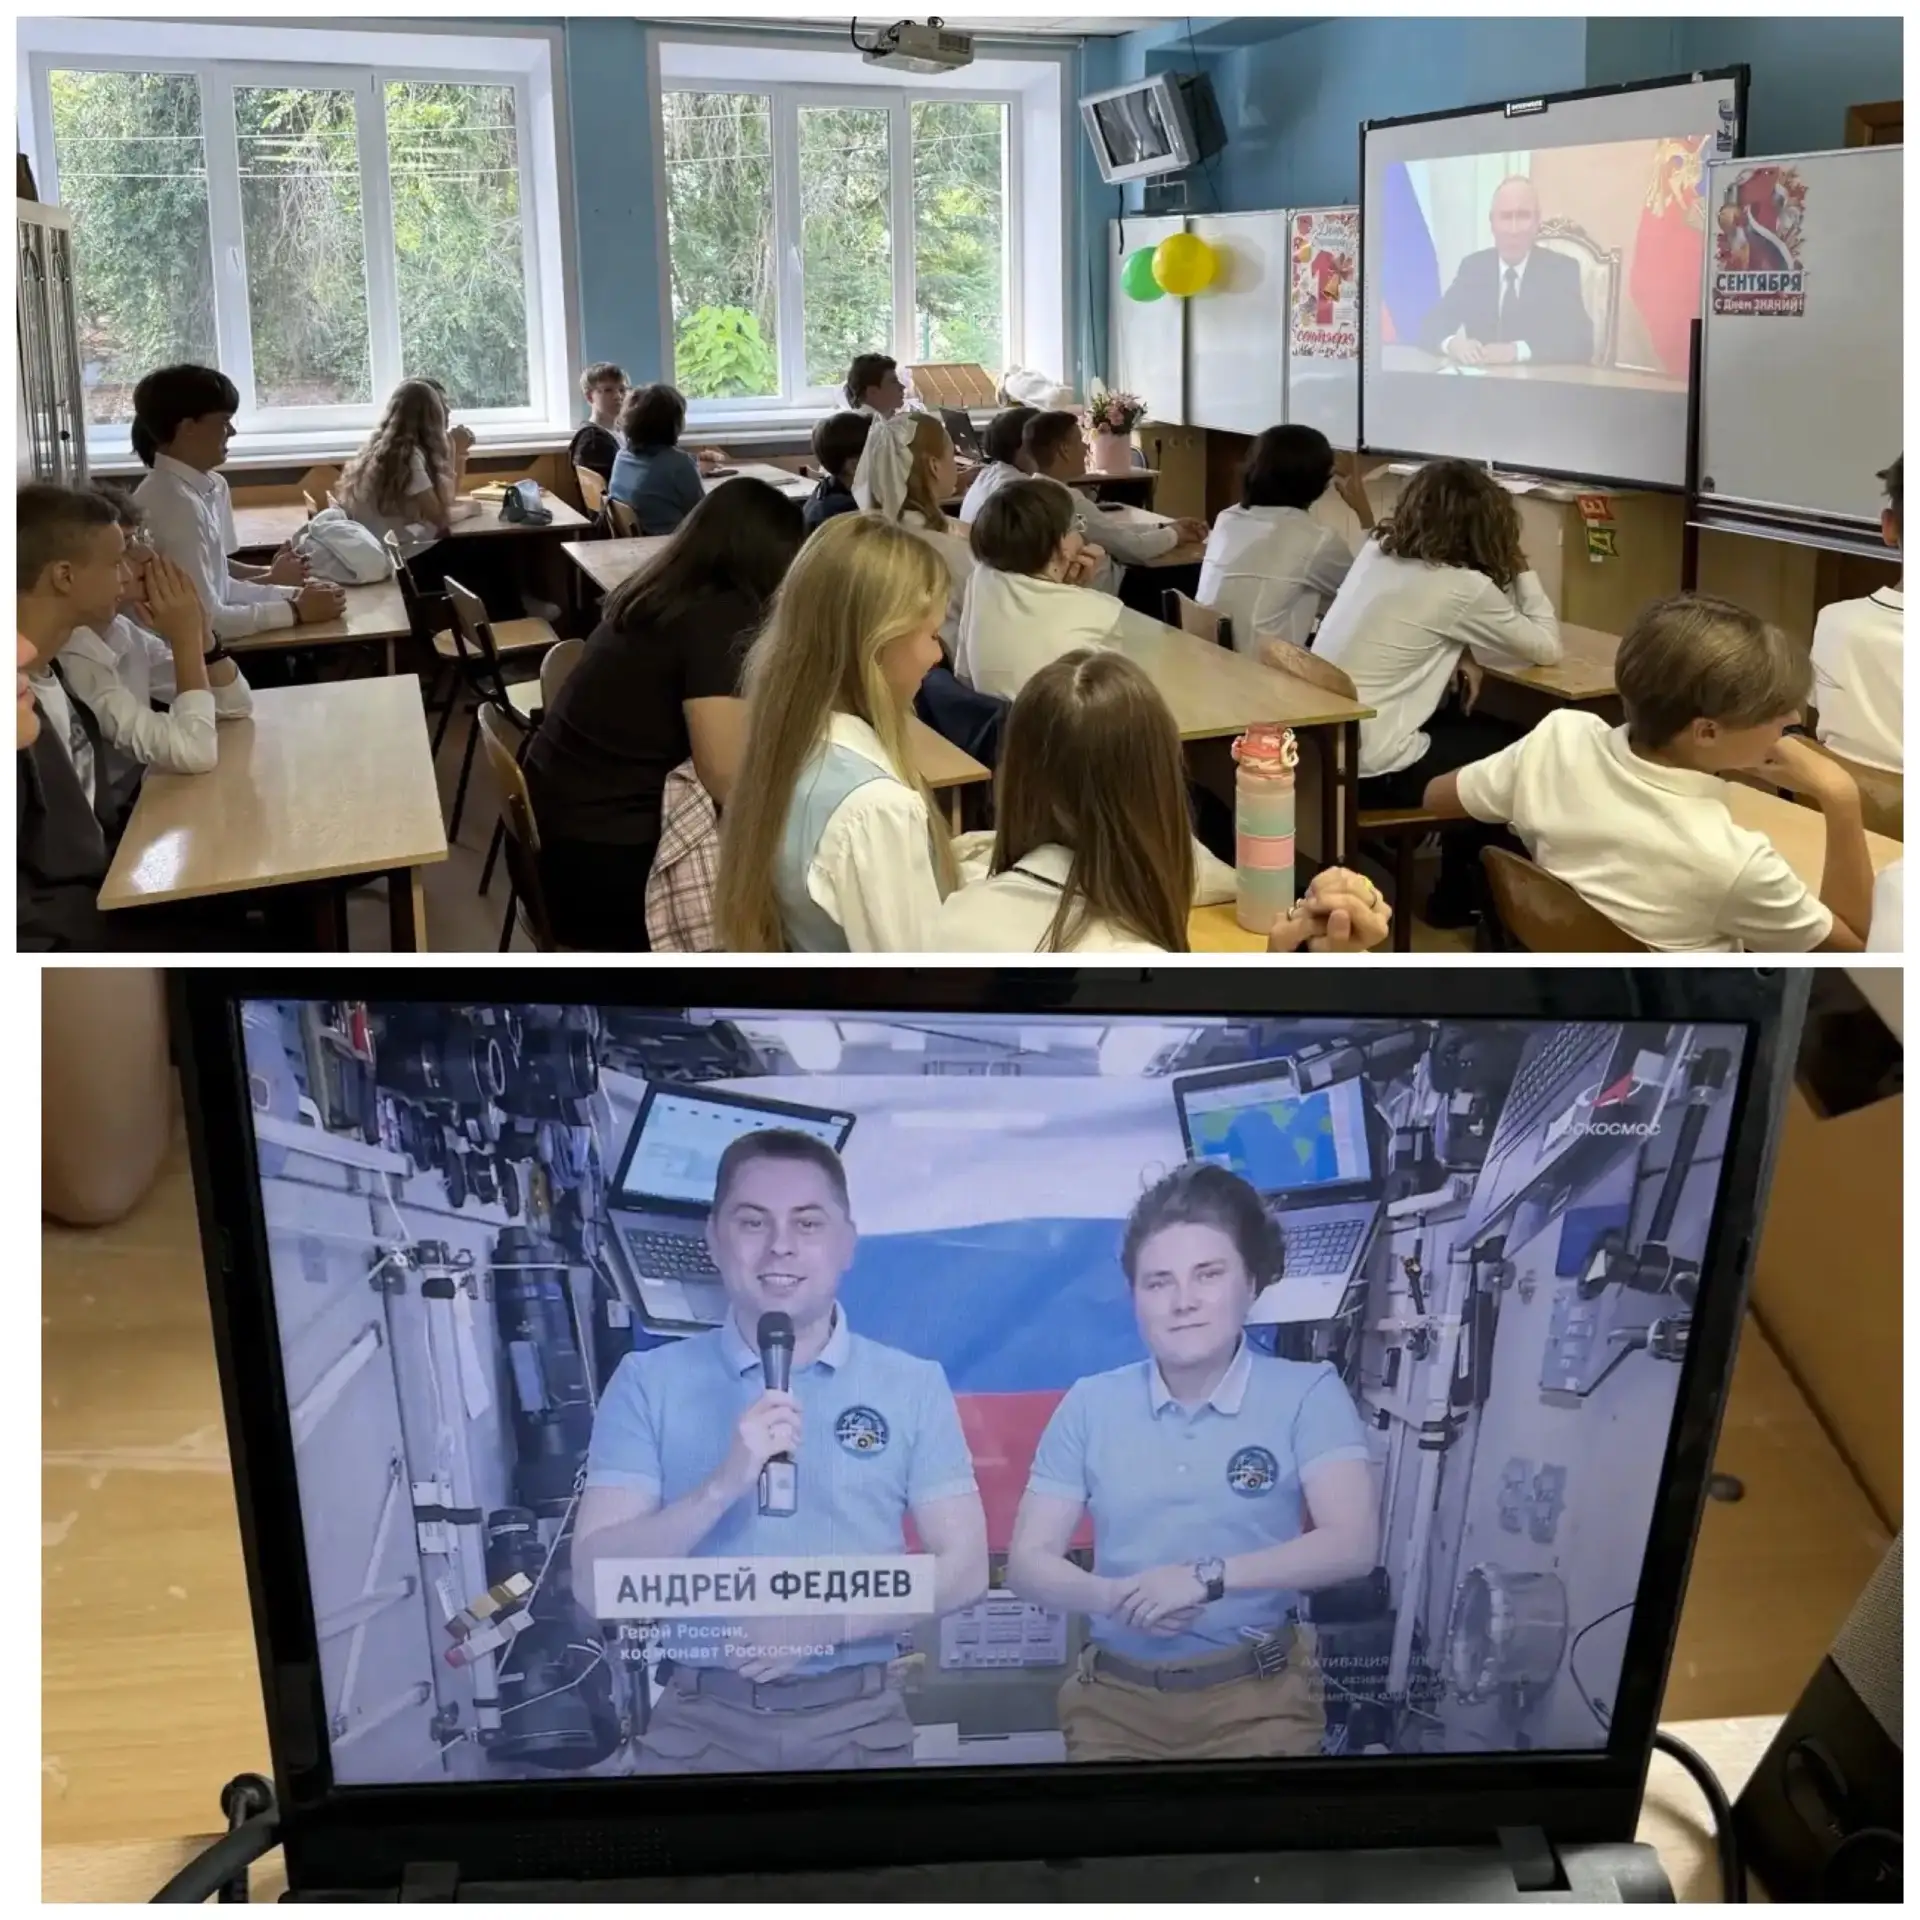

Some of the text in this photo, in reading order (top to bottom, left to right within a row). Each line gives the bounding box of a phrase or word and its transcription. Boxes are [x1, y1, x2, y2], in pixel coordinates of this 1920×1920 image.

[1716, 274, 1802, 291] СЕНТЯБРЯ
[617, 1567, 912, 1606] АНДРЕЙ ФЕДЯЕВ
[619, 1622, 748, 1642] Герой России,
[620, 1642, 834, 1661] космонавт Роскосмоса
